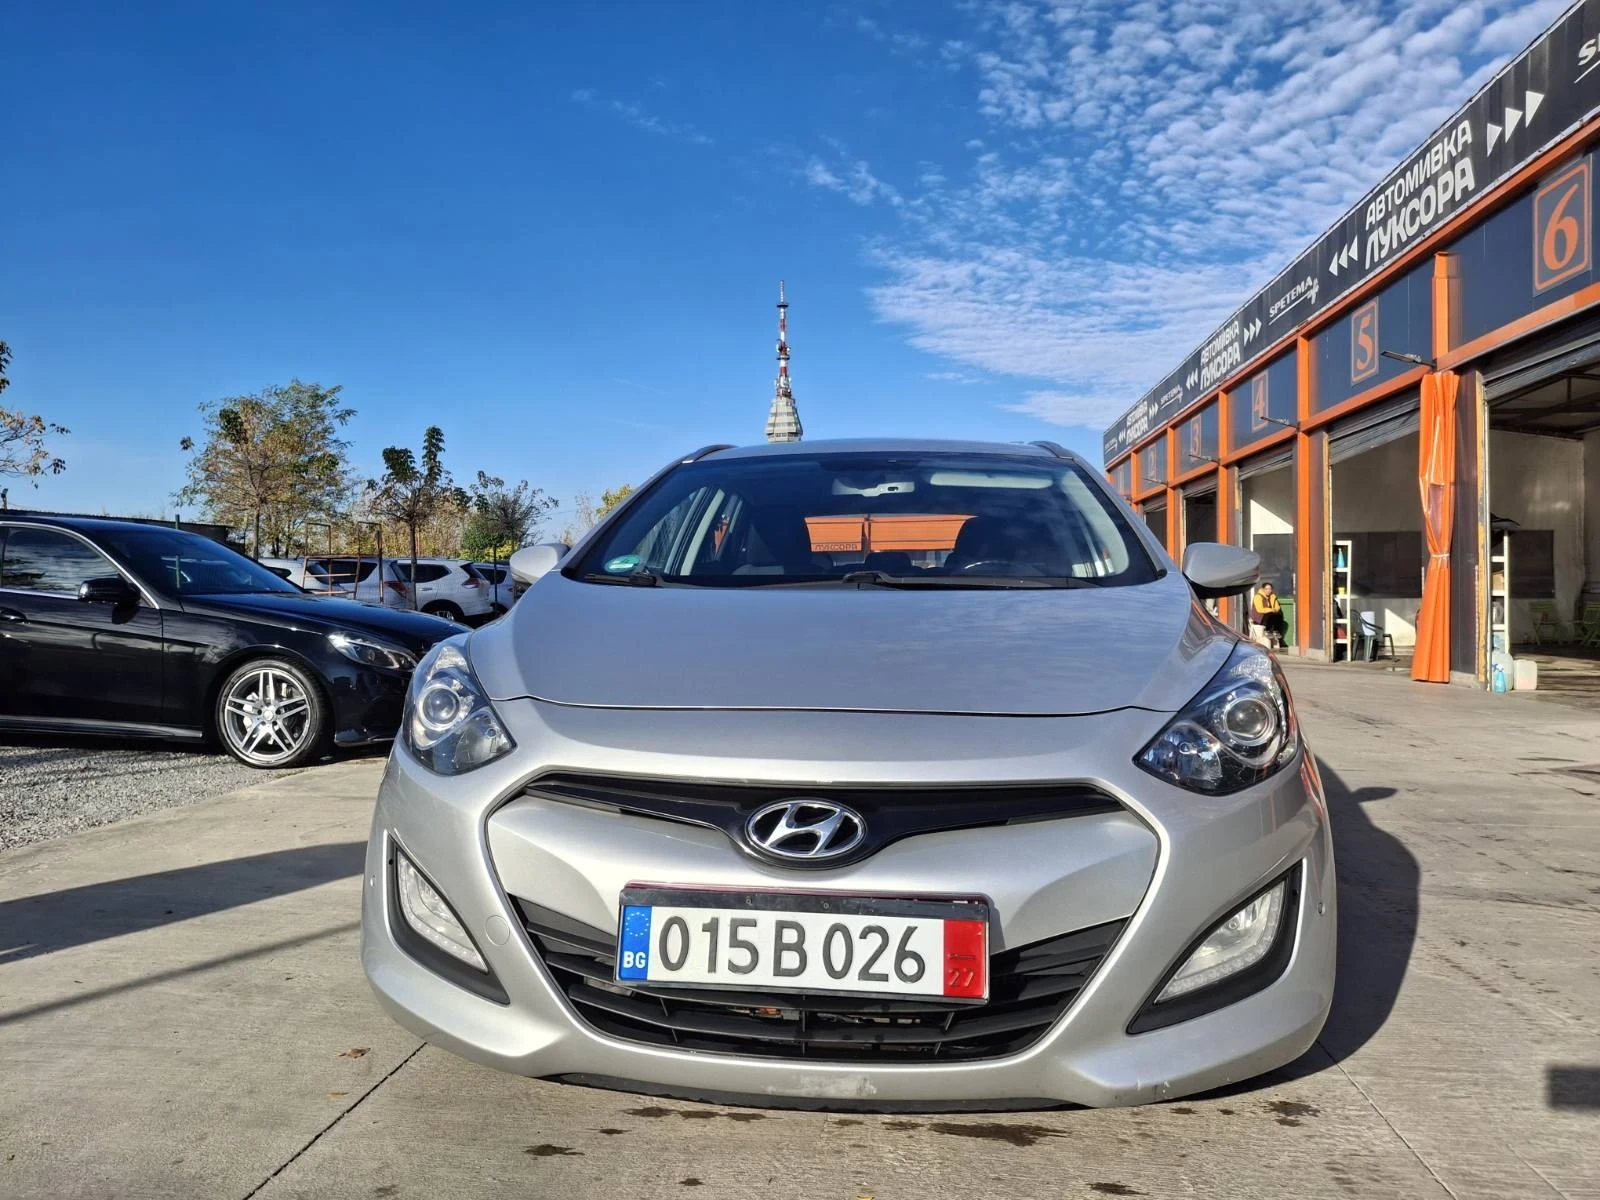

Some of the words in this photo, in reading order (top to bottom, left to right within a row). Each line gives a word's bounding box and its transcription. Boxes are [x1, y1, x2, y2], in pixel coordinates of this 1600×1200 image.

[1578, 33, 1600, 65] S
[1365, 119, 1473, 231] АВТОМИВКА
[1365, 157, 1476, 270] ЛУКСОРА
[1542, 183, 1579, 271] 6
[1269, 276, 1313, 318] SPETEMA
[1200, 320, 1240, 366] АВТОМИВКА
[1356, 311, 1374, 370] 5
[1200, 341, 1241, 391] ЛУКСОРА
[623, 951, 647, 969] BG
